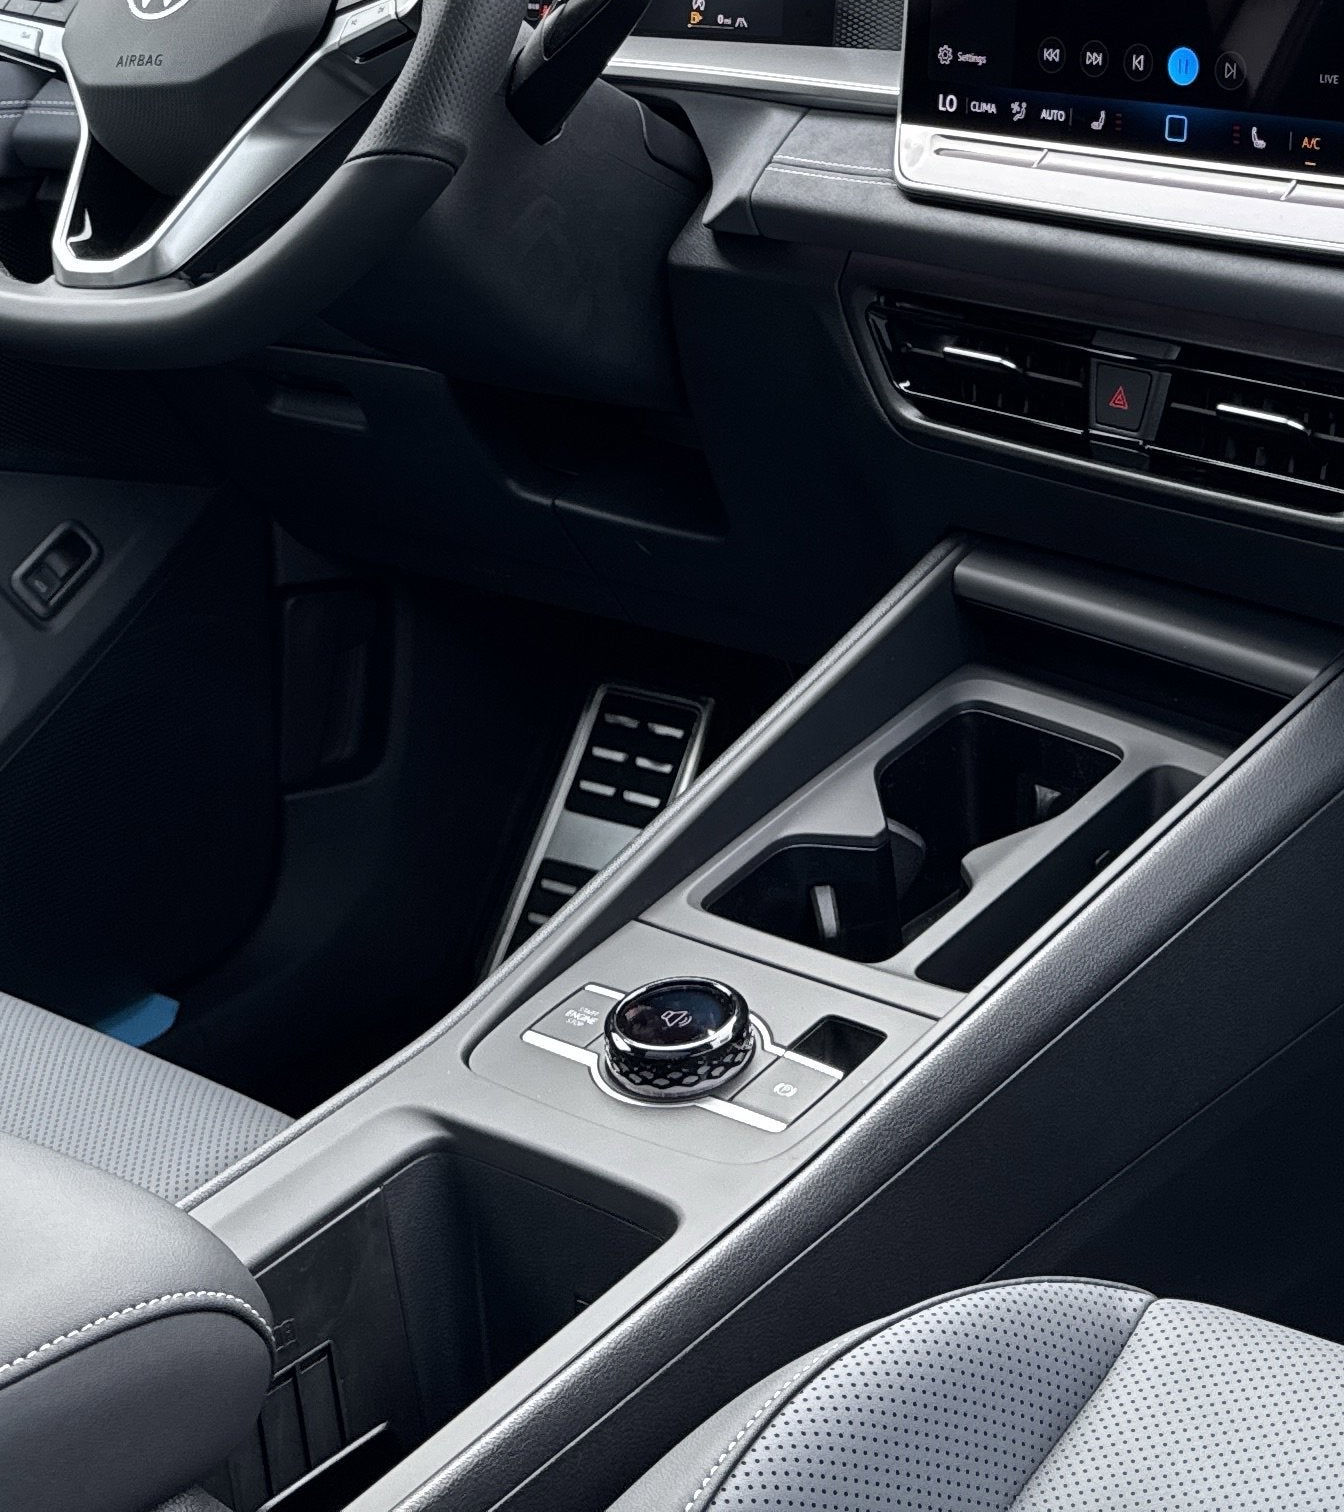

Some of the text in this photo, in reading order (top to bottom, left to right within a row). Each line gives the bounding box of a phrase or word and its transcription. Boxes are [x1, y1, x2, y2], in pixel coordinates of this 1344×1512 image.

[115, 54, 164, 69] AIRBAG
[957, 51, 987, 66] Settings
[1319, 73, 1339, 85] LIVE
[938, 93, 957, 112] LO
[970, 100, 997, 115] CLIMA
[1040, 108, 1066, 122] AUTO
[1301, 137, 1321, 150] A/C
[564, 1010, 599, 1026] ENGINE
